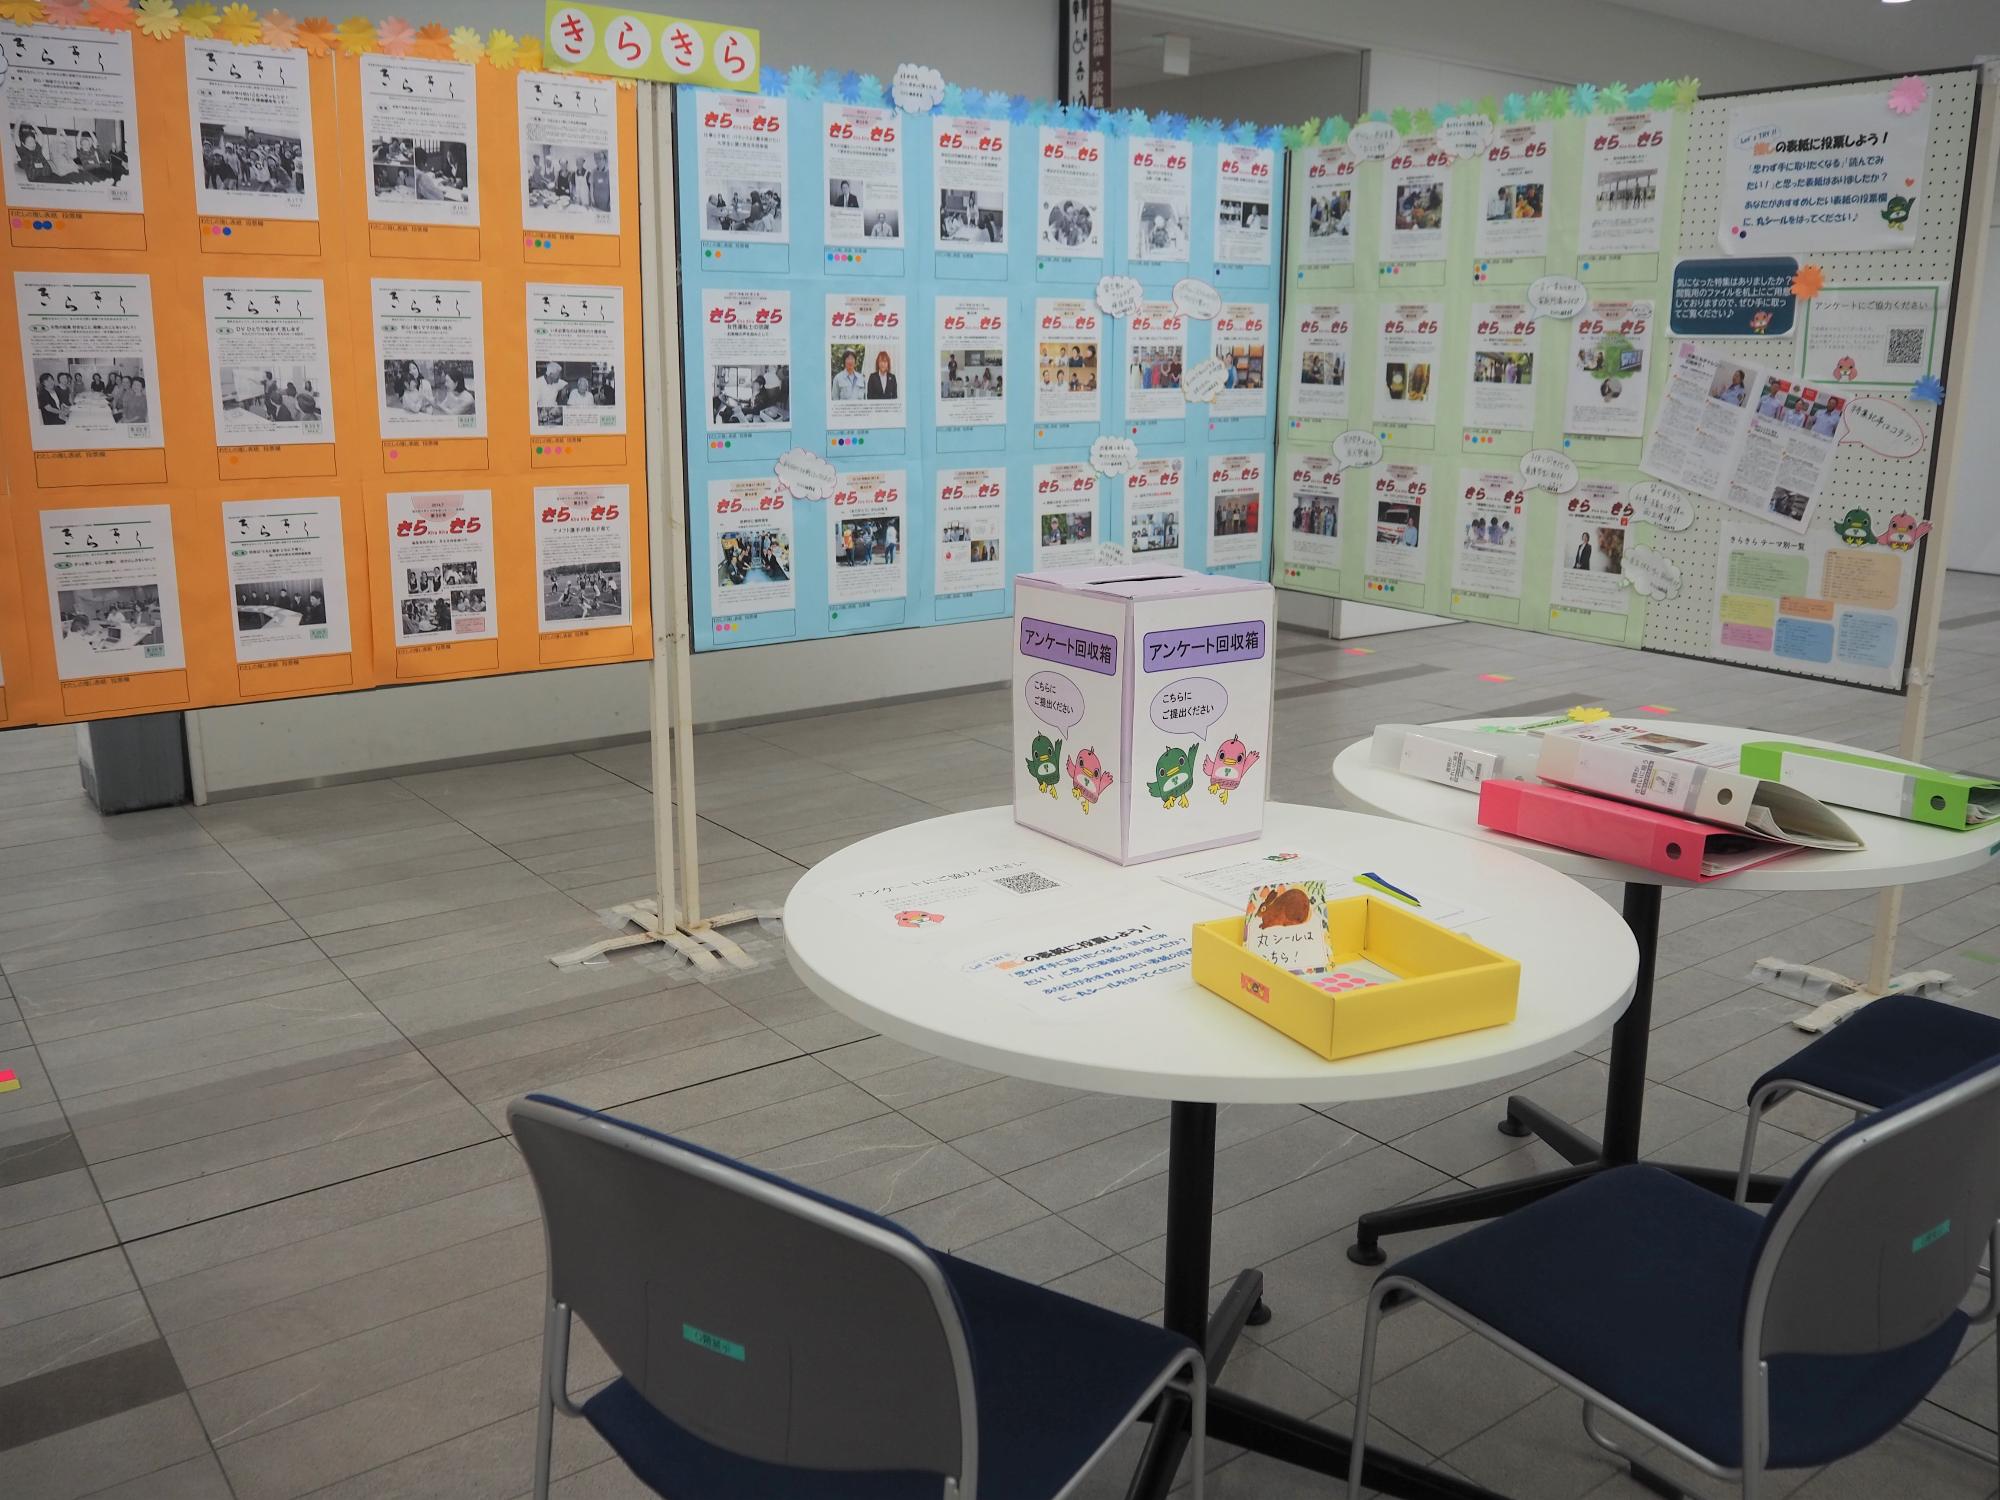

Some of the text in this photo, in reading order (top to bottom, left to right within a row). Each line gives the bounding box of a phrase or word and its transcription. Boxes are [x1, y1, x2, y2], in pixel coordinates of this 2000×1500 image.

[560, 14, 746, 74] きらきら
[1025, 630, 1112, 664] アンケート回収箱
[1149, 631, 1259, 661] アンケート回収箱
[1034, 681, 1057, 694] こちらに
[1034, 696, 1074, 714] ご提出ください
[1162, 692, 1192, 704] こちらに
[1162, 704, 1214, 720] ご提出ください
[1257, 931, 1314, 948] 丸シールは
